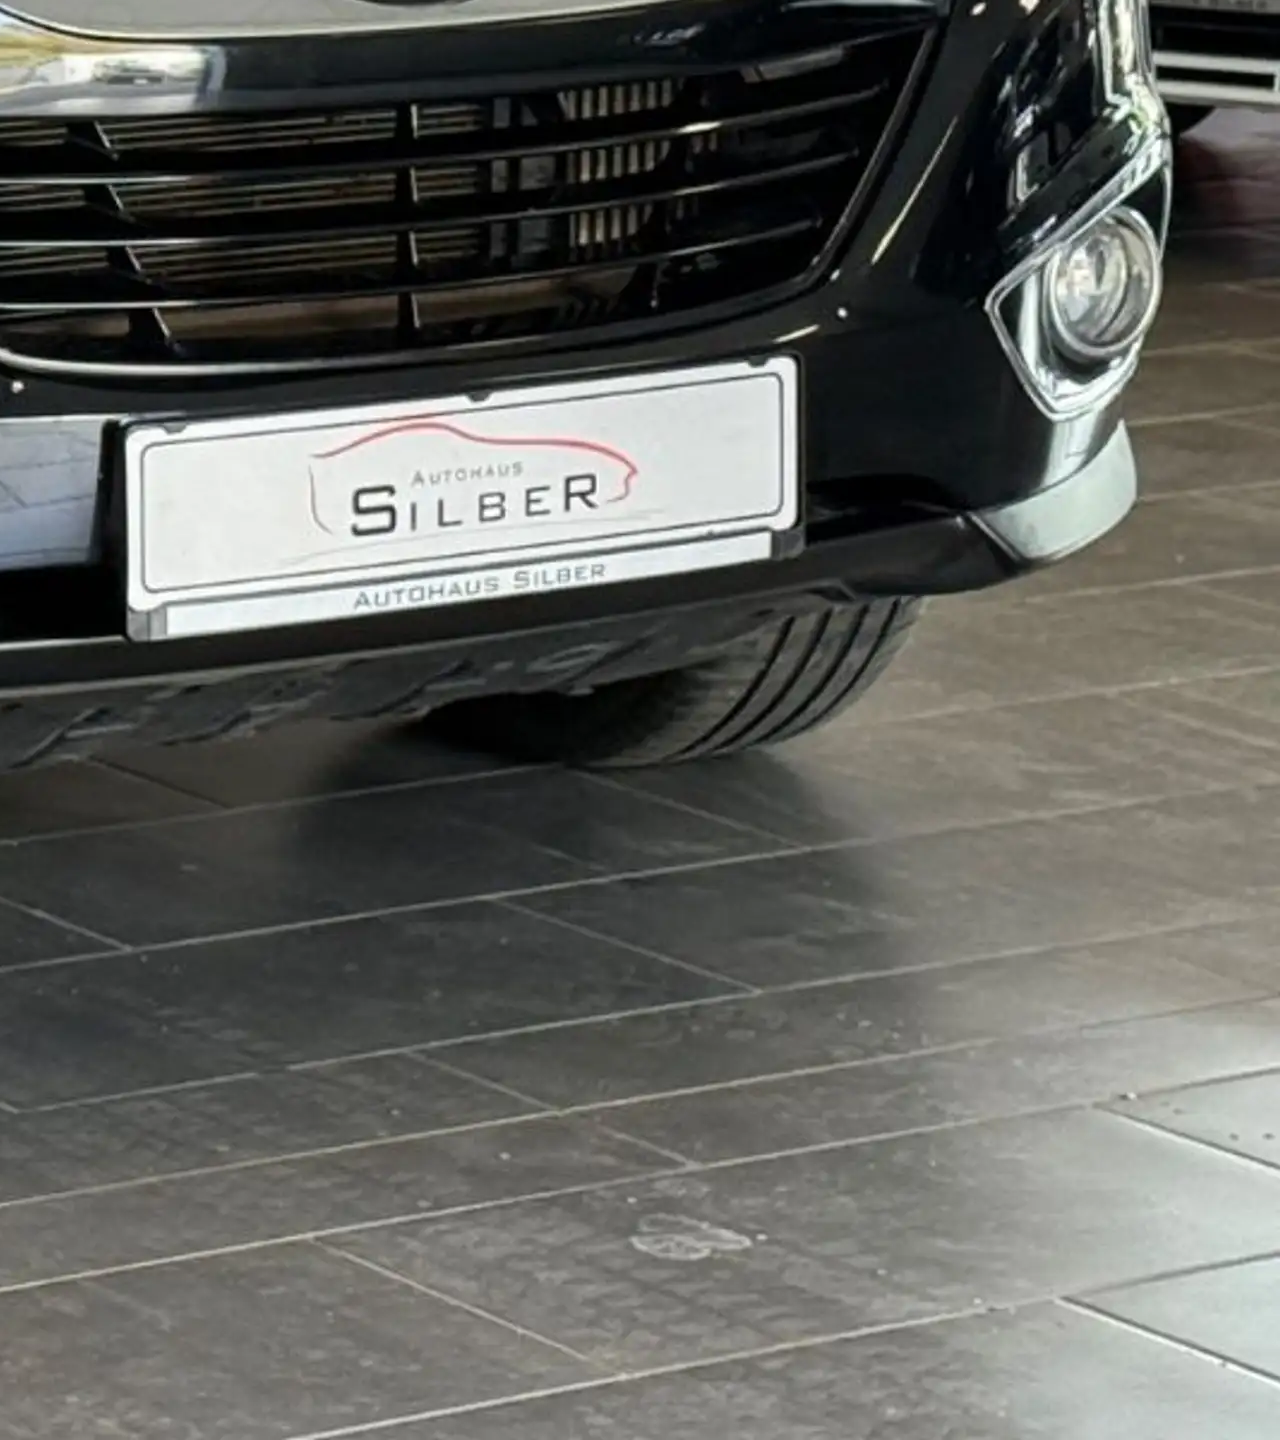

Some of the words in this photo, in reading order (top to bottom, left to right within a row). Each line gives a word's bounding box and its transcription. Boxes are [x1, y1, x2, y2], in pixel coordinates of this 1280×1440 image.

[410, 461, 523, 487] AUTOHAUS
[351, 473, 599, 537] SILBER
[353, 577, 500, 610] AUTOHAUS
[513, 563, 607, 590] SILBER
